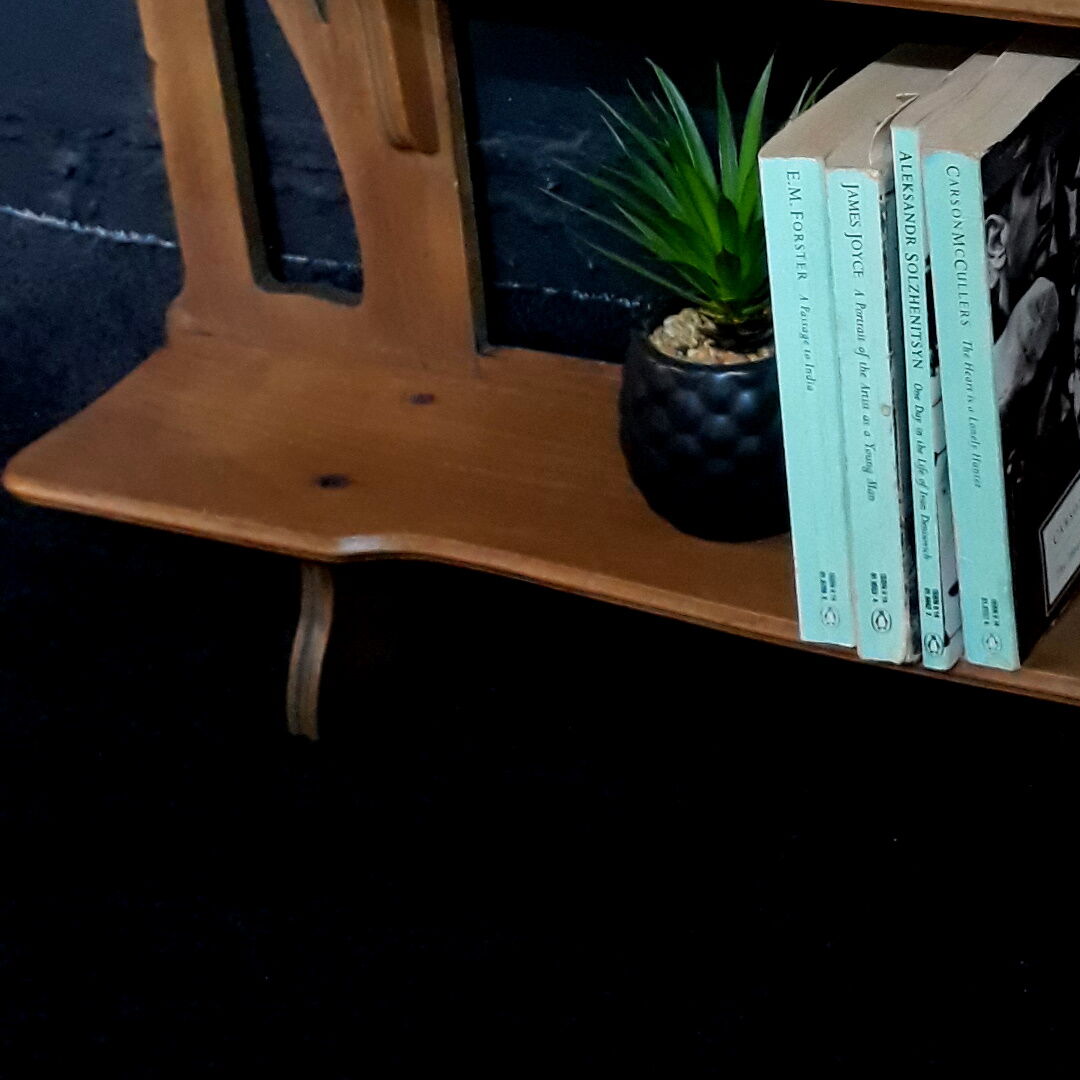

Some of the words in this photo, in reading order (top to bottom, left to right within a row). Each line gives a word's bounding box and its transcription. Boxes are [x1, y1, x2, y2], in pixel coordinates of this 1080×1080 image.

[841, 183, 863, 228] JAMES
[898, 151, 917, 246] ALEKSANDR
[945, 165, 963, 231] CARSON
[789, 210, 808, 281] FORSTER
[843, 232, 865, 279] JOYCE
[797, 305, 811, 345] Passage
[855, 302, 867, 342] Portrait
[904, 252, 924, 370] SOLZHENITSYN
[853, 346, 870, 359] of
[961, 340, 974, 358] The
[804, 363, 817, 392] India
[858, 361, 870, 379] the
[963, 361, 975, 392] Heart
[913, 383, 924, 401] One
[913, 404, 925, 424] Day
[862, 443, 877, 474] Young
[916, 440, 928, 455] the
[915, 458, 930, 475] Life
[866, 478, 878, 502] Man
[916, 478, 930, 490] of
